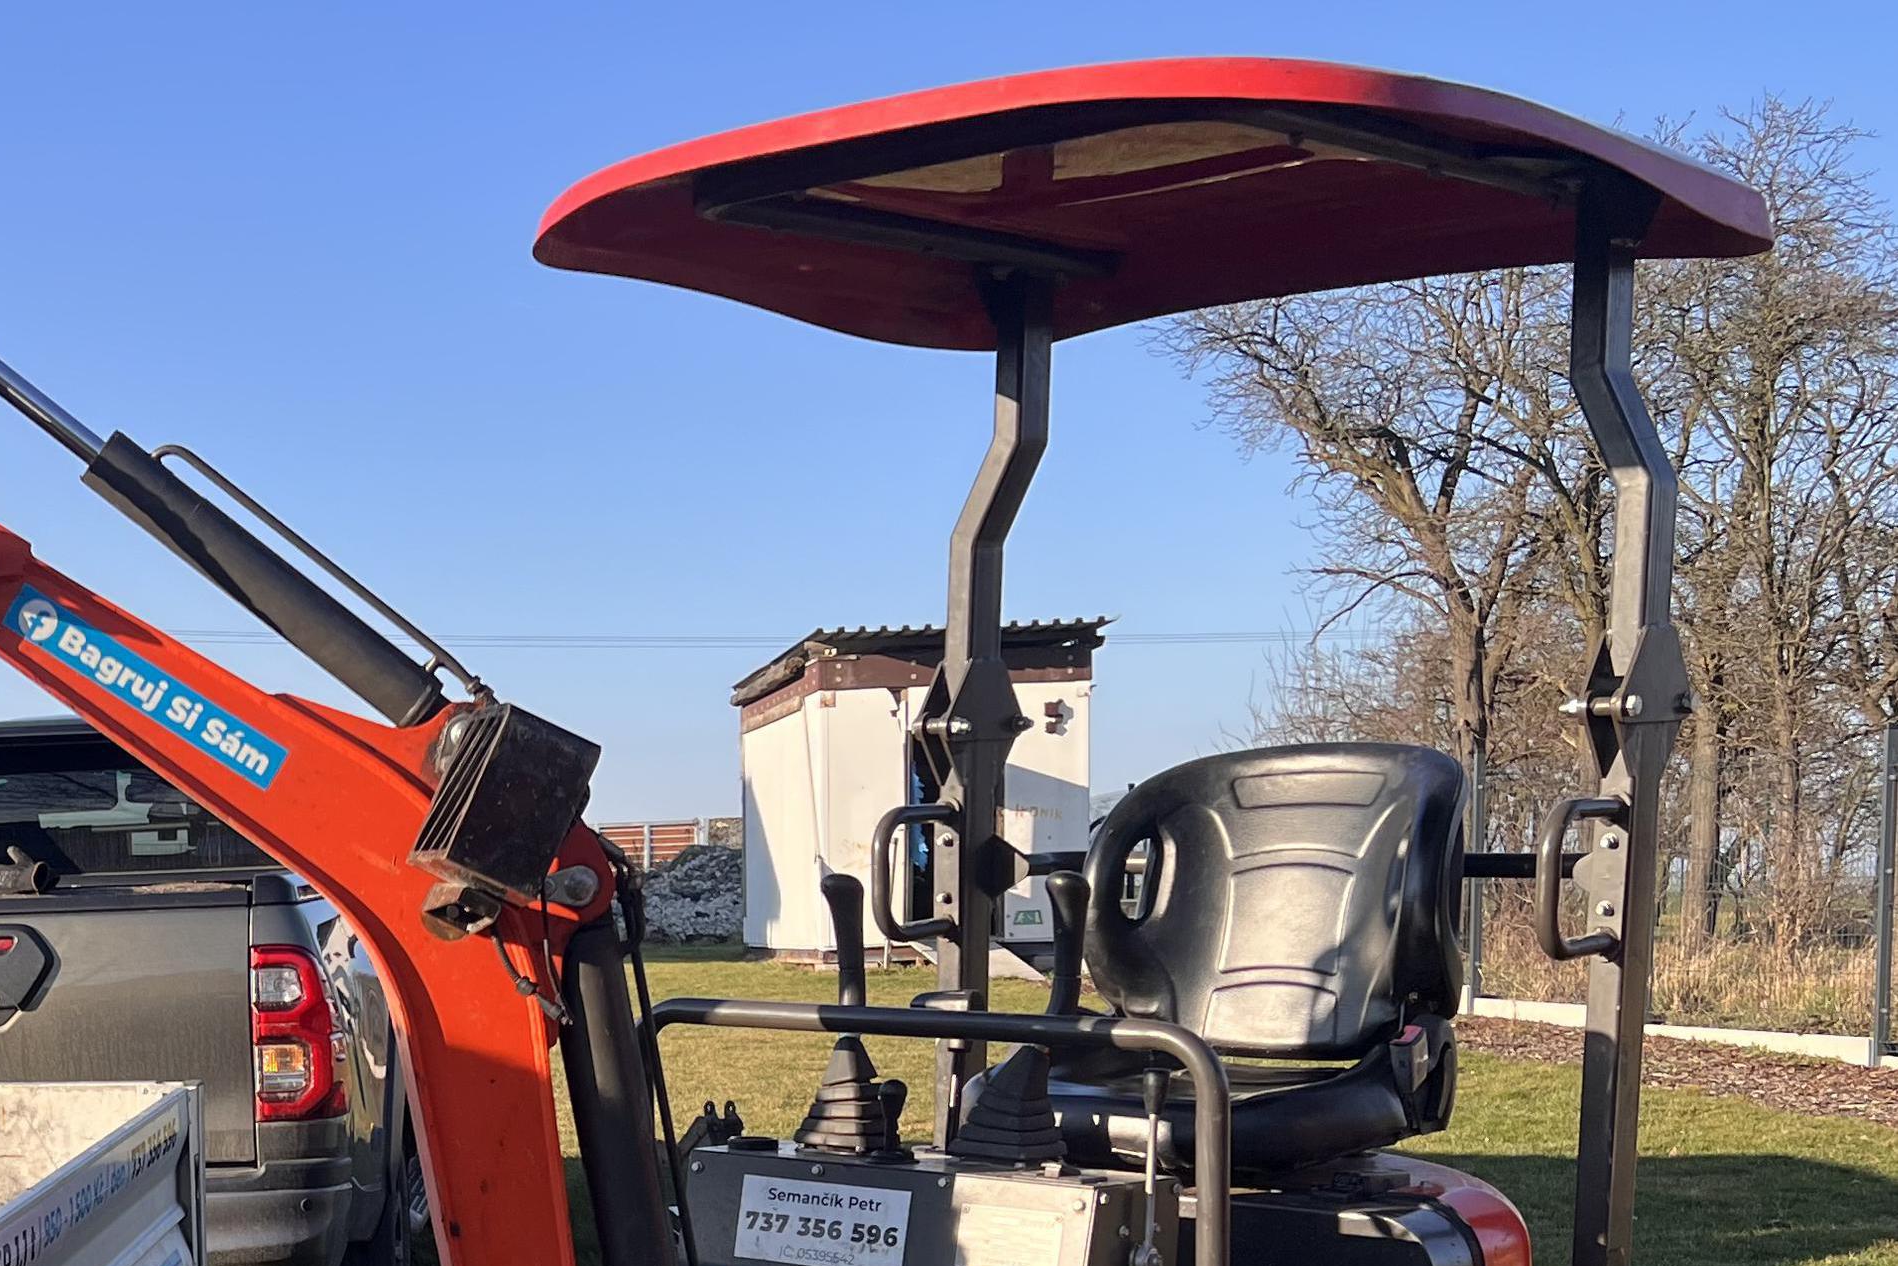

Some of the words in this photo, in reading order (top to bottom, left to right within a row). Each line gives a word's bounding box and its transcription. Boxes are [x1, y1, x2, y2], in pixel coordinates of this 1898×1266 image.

[57, 625, 168, 712] Bagruj
[166, 696, 203, 731] Si
[201, 717, 270, 776] Sám
[767, 1187, 843, 1208] Semančík
[848, 1196, 882, 1212] Petr
[745, 1211, 790, 1233] 737
[797, 1216, 843, 1240] 356
[851, 1223, 898, 1247] 596
